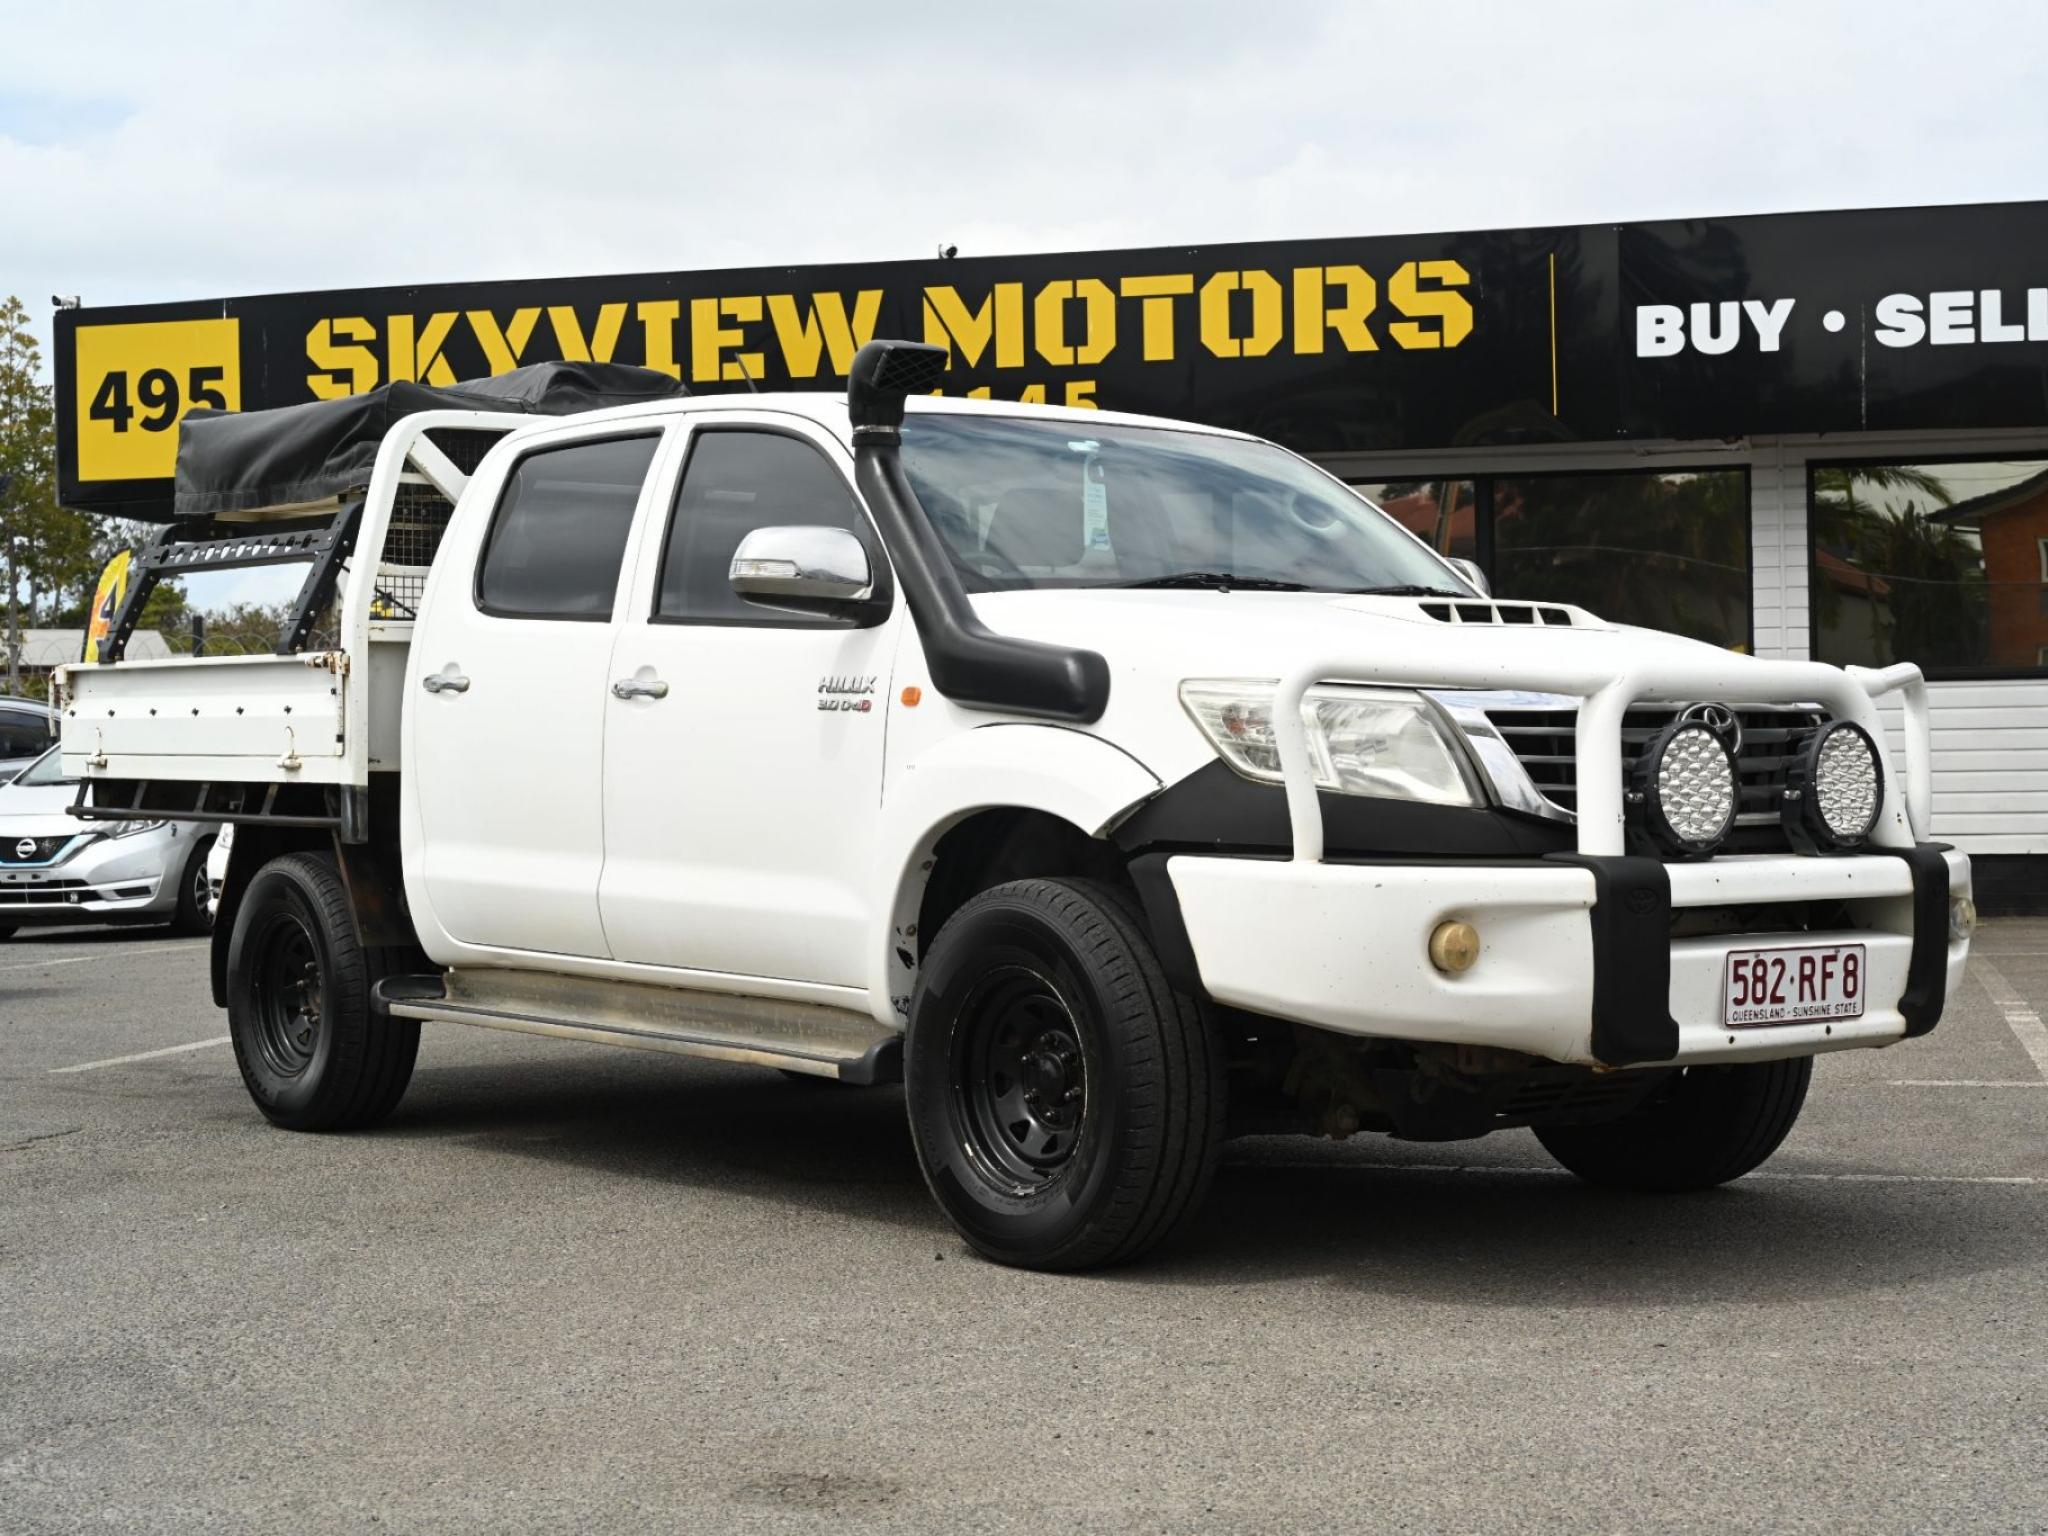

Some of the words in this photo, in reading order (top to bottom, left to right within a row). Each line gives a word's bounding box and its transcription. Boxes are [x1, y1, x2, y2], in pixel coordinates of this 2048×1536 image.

[305, 289, 883, 400] SKYVIEW
[923, 259, 1474, 371] MOTORS
[1636, 298, 1796, 358] BUY
[90, 366, 227, 432] 495
[1732, 1008, 1785, 1022] QUEENSLAND
[1793, 1004, 1831, 1018] SUNSHINE
[1834, 1003, 1857, 1014] STATE
